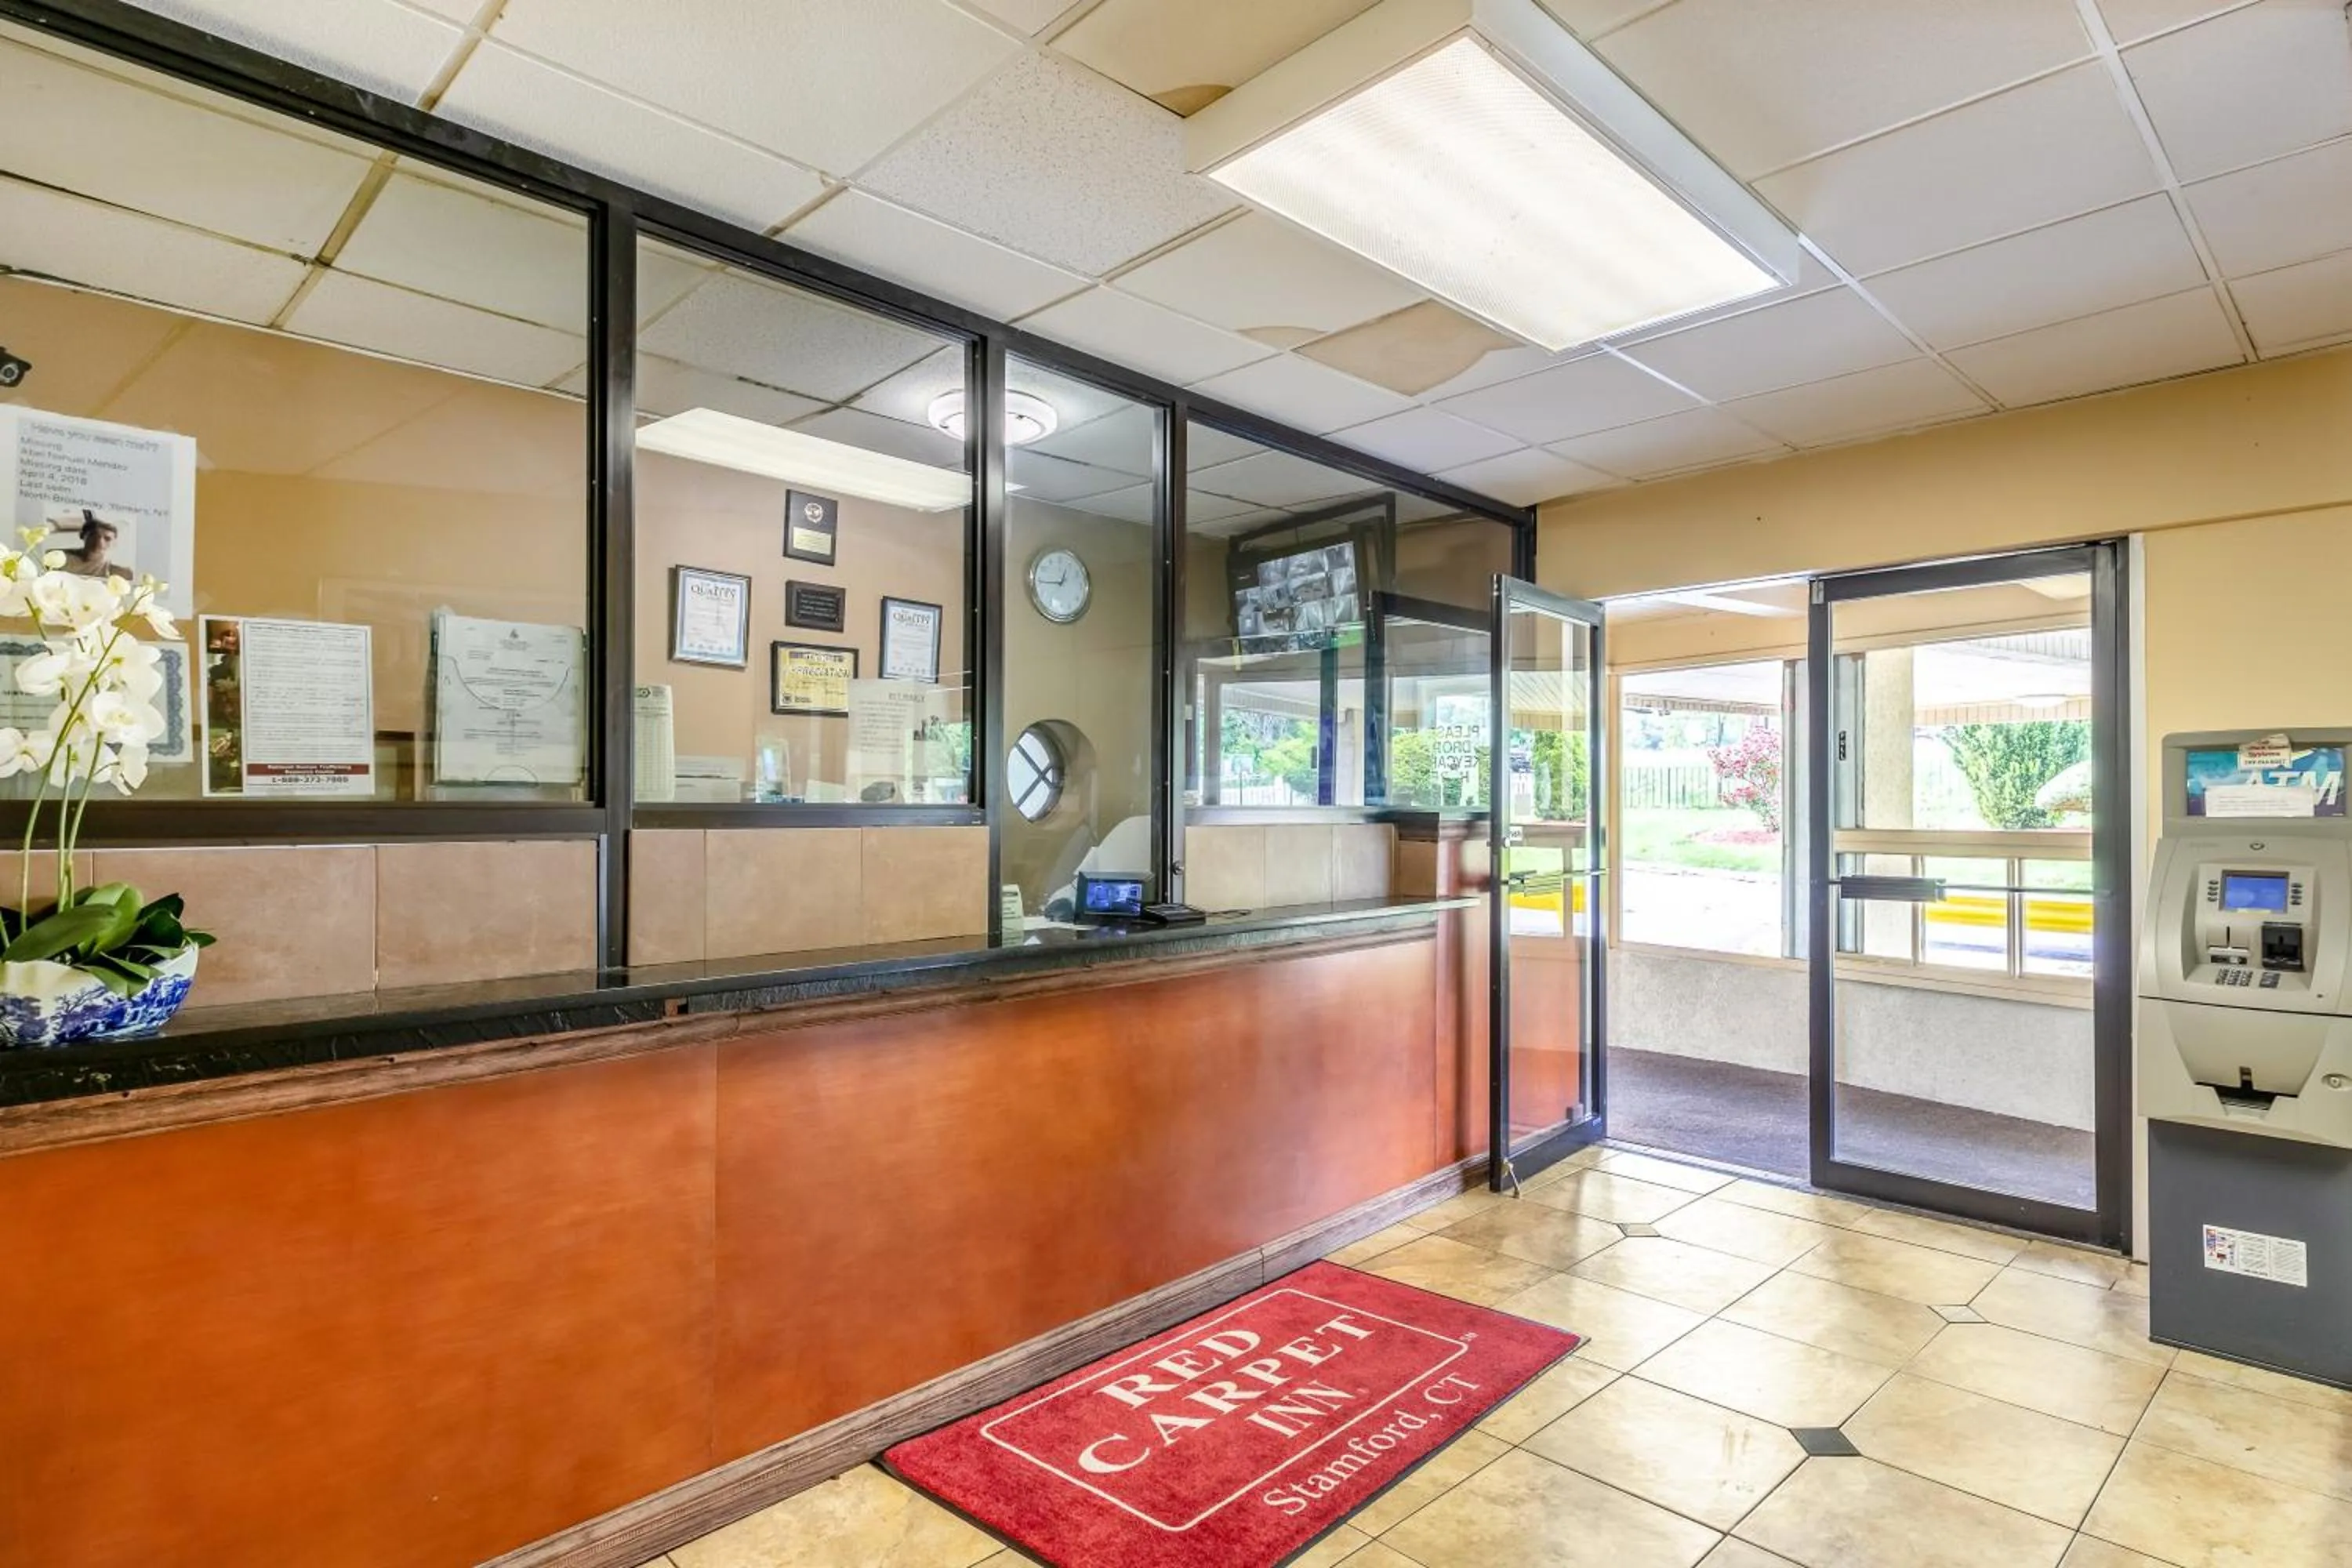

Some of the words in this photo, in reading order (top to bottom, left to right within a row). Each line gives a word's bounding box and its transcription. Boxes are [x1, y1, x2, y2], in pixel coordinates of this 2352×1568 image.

[20, 458, 63, 472] Missing
[20, 479, 43, 489] Last
[1077, 1314, 1375, 1474] CARPET
[1095, 1329, 1261, 1410] RED
[1244, 1379, 1355, 1439] INN
[1263, 1410, 1443, 1515] Stamford,
[1423, 1372, 1481, 1406] CT
